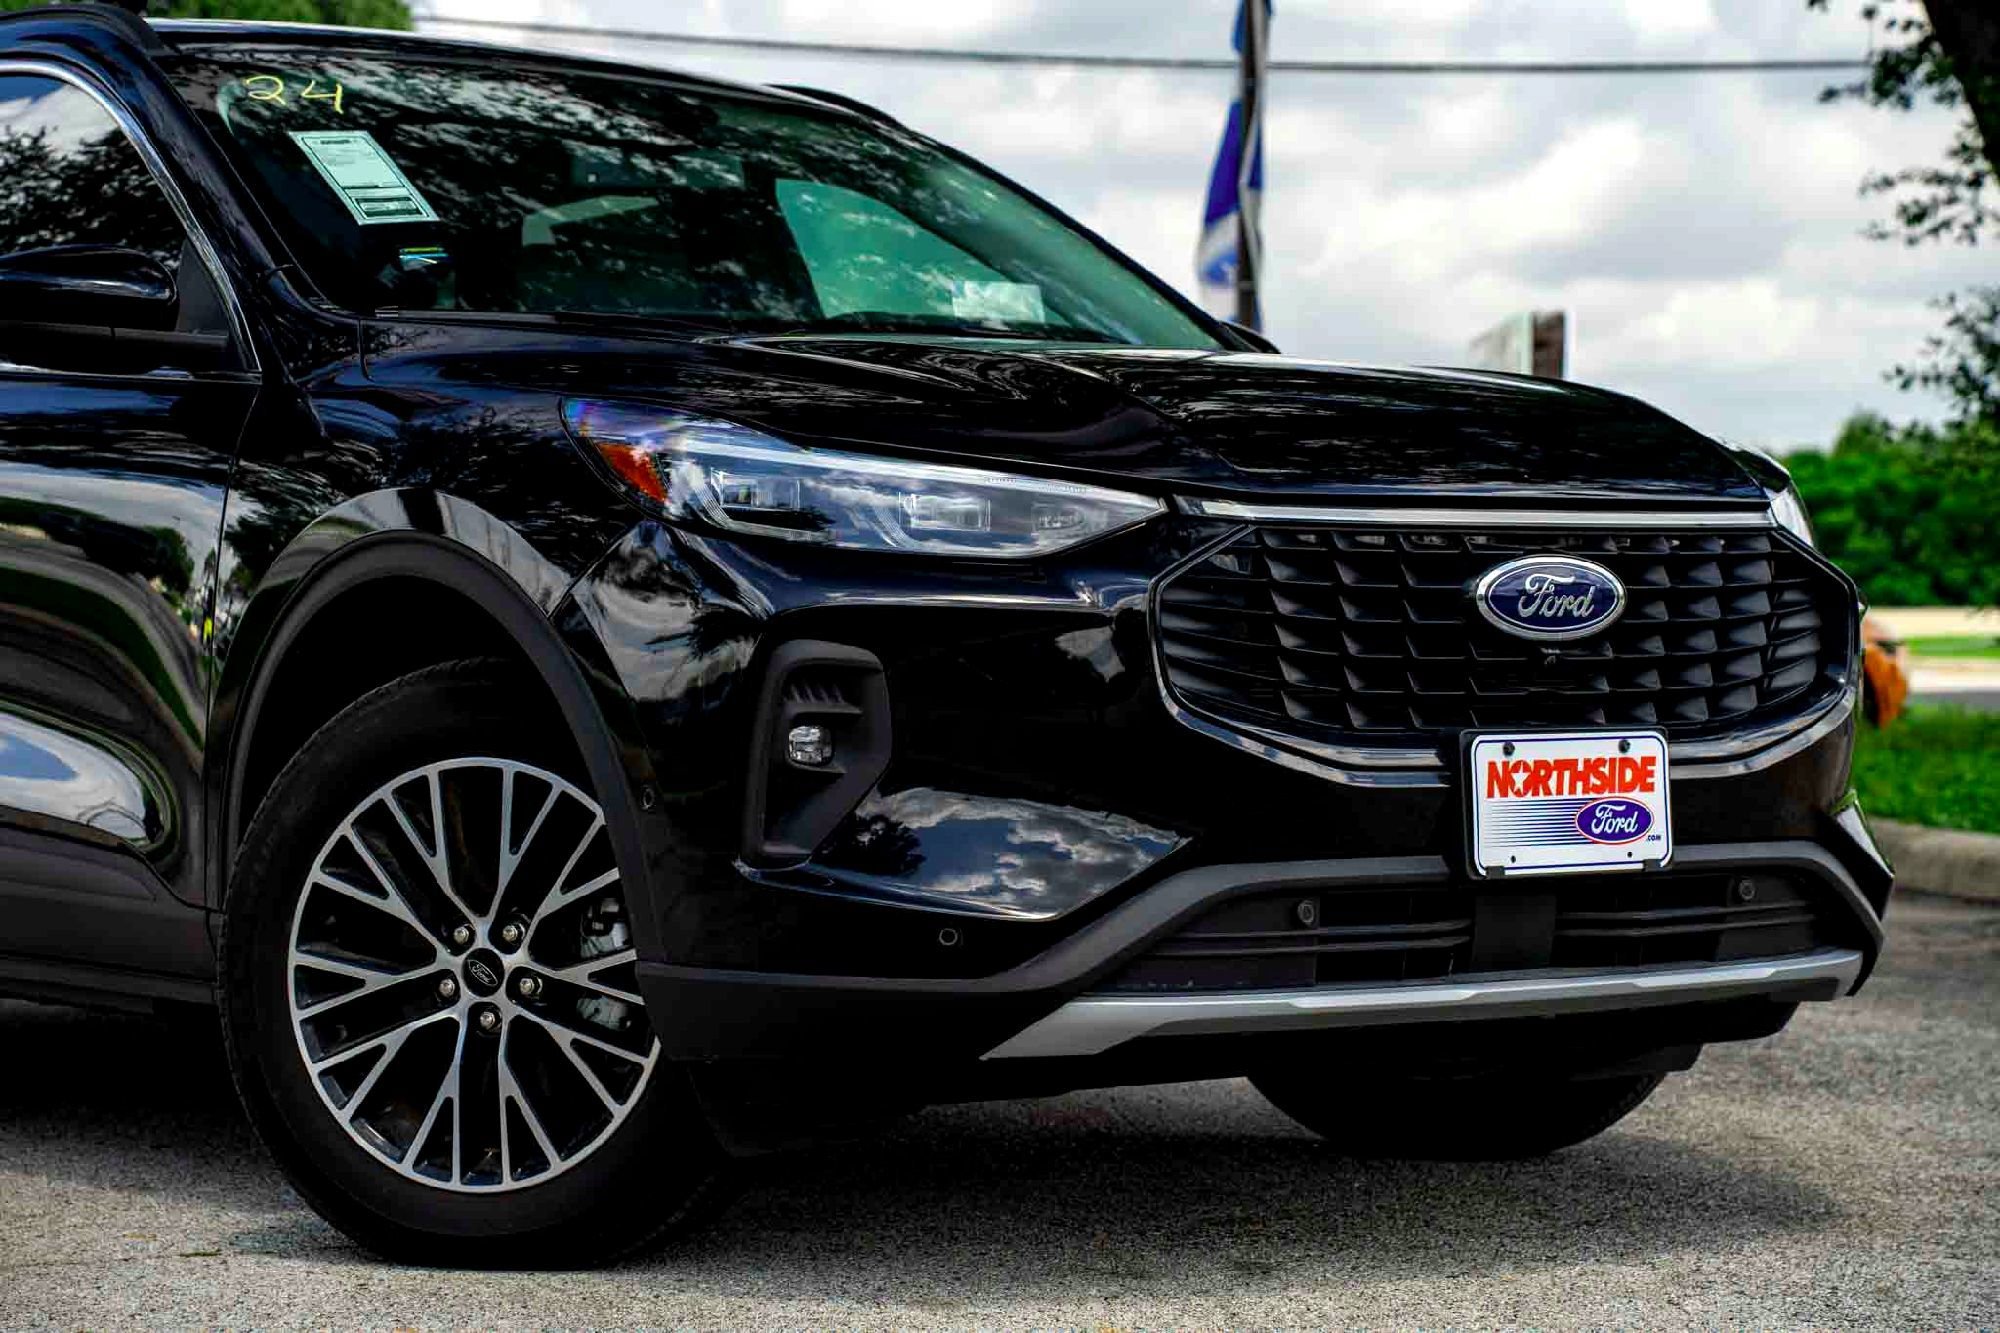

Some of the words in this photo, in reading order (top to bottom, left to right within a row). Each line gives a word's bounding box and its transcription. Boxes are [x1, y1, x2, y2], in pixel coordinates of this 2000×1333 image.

[244, 75, 344, 114] 24
[1518, 573, 1597, 618] Ford
[1487, 756, 1657, 799] NORTHSIDE
[1591, 804, 1639, 834] Ford
[472, 963, 493, 983] Ford
